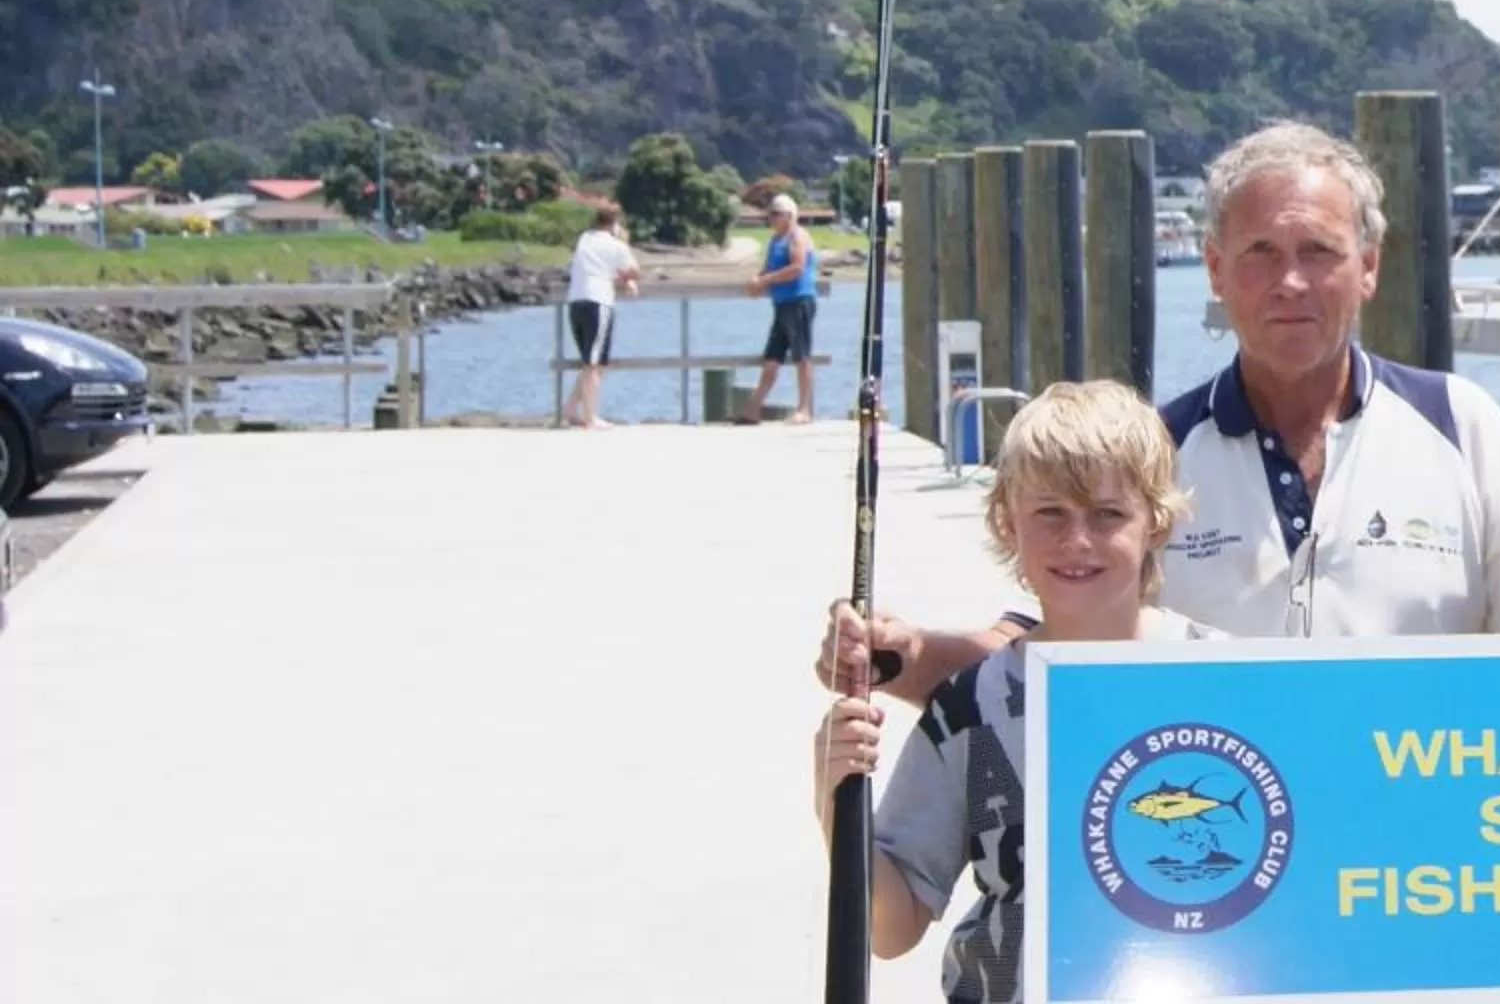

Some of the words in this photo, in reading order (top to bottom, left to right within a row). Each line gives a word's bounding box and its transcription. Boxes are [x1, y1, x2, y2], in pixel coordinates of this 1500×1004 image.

[1088, 749, 1140, 894] WHAKATANE
[1145, 729, 1288, 817] SPORTFISHING
[1253, 829, 1289, 890] CLUB
[1173, 911, 1205, 929] NZ
